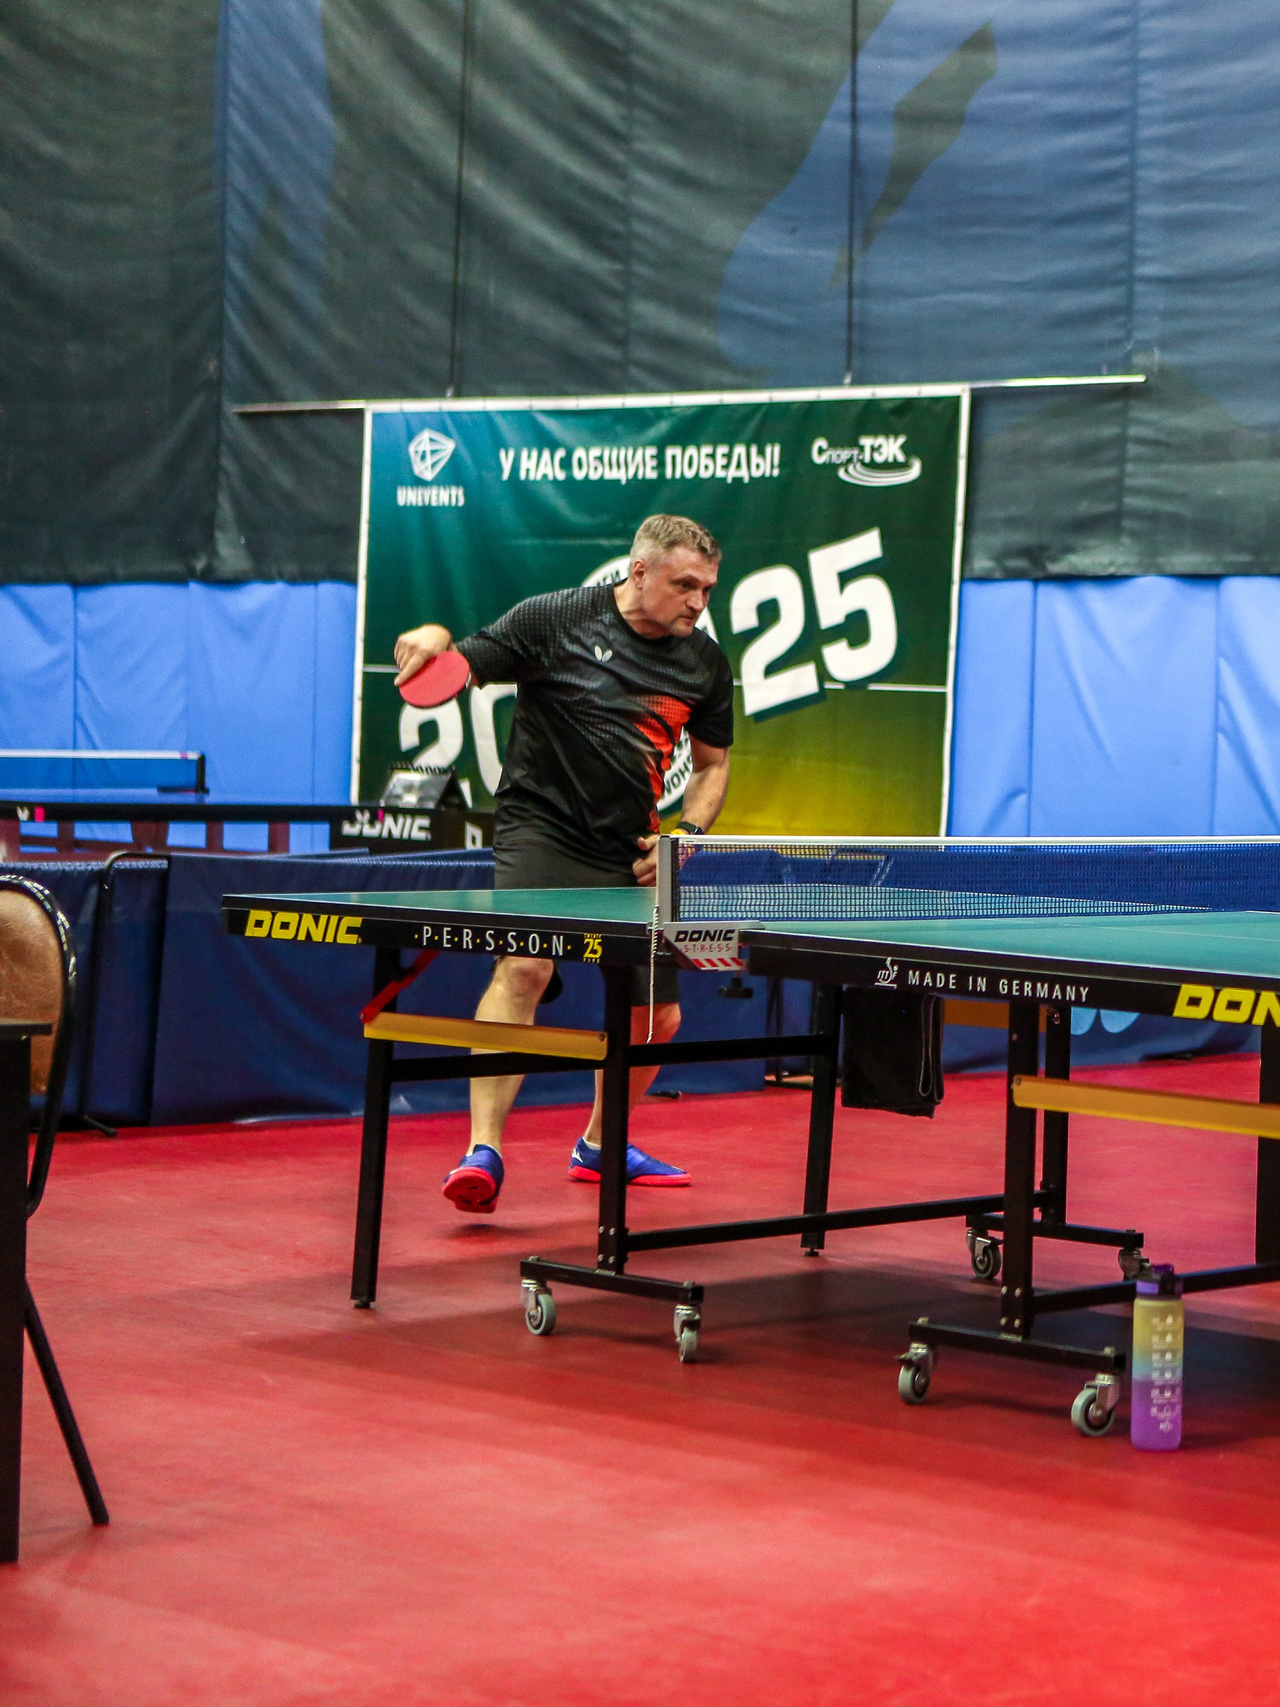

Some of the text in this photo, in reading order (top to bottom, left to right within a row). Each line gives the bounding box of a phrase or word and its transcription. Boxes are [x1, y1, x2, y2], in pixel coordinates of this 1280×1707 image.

[500, 443, 781, 485] У НАС ОБЩИЕ ПОБЕДЫ!
[397, 485, 465, 507] UNIVENTS
[244, 909, 363, 945] DONIC
[674, 929, 736, 943] DONIC
[583, 937, 602, 959] 25
[908, 970, 1090, 1003] MADE IN GERMANY
